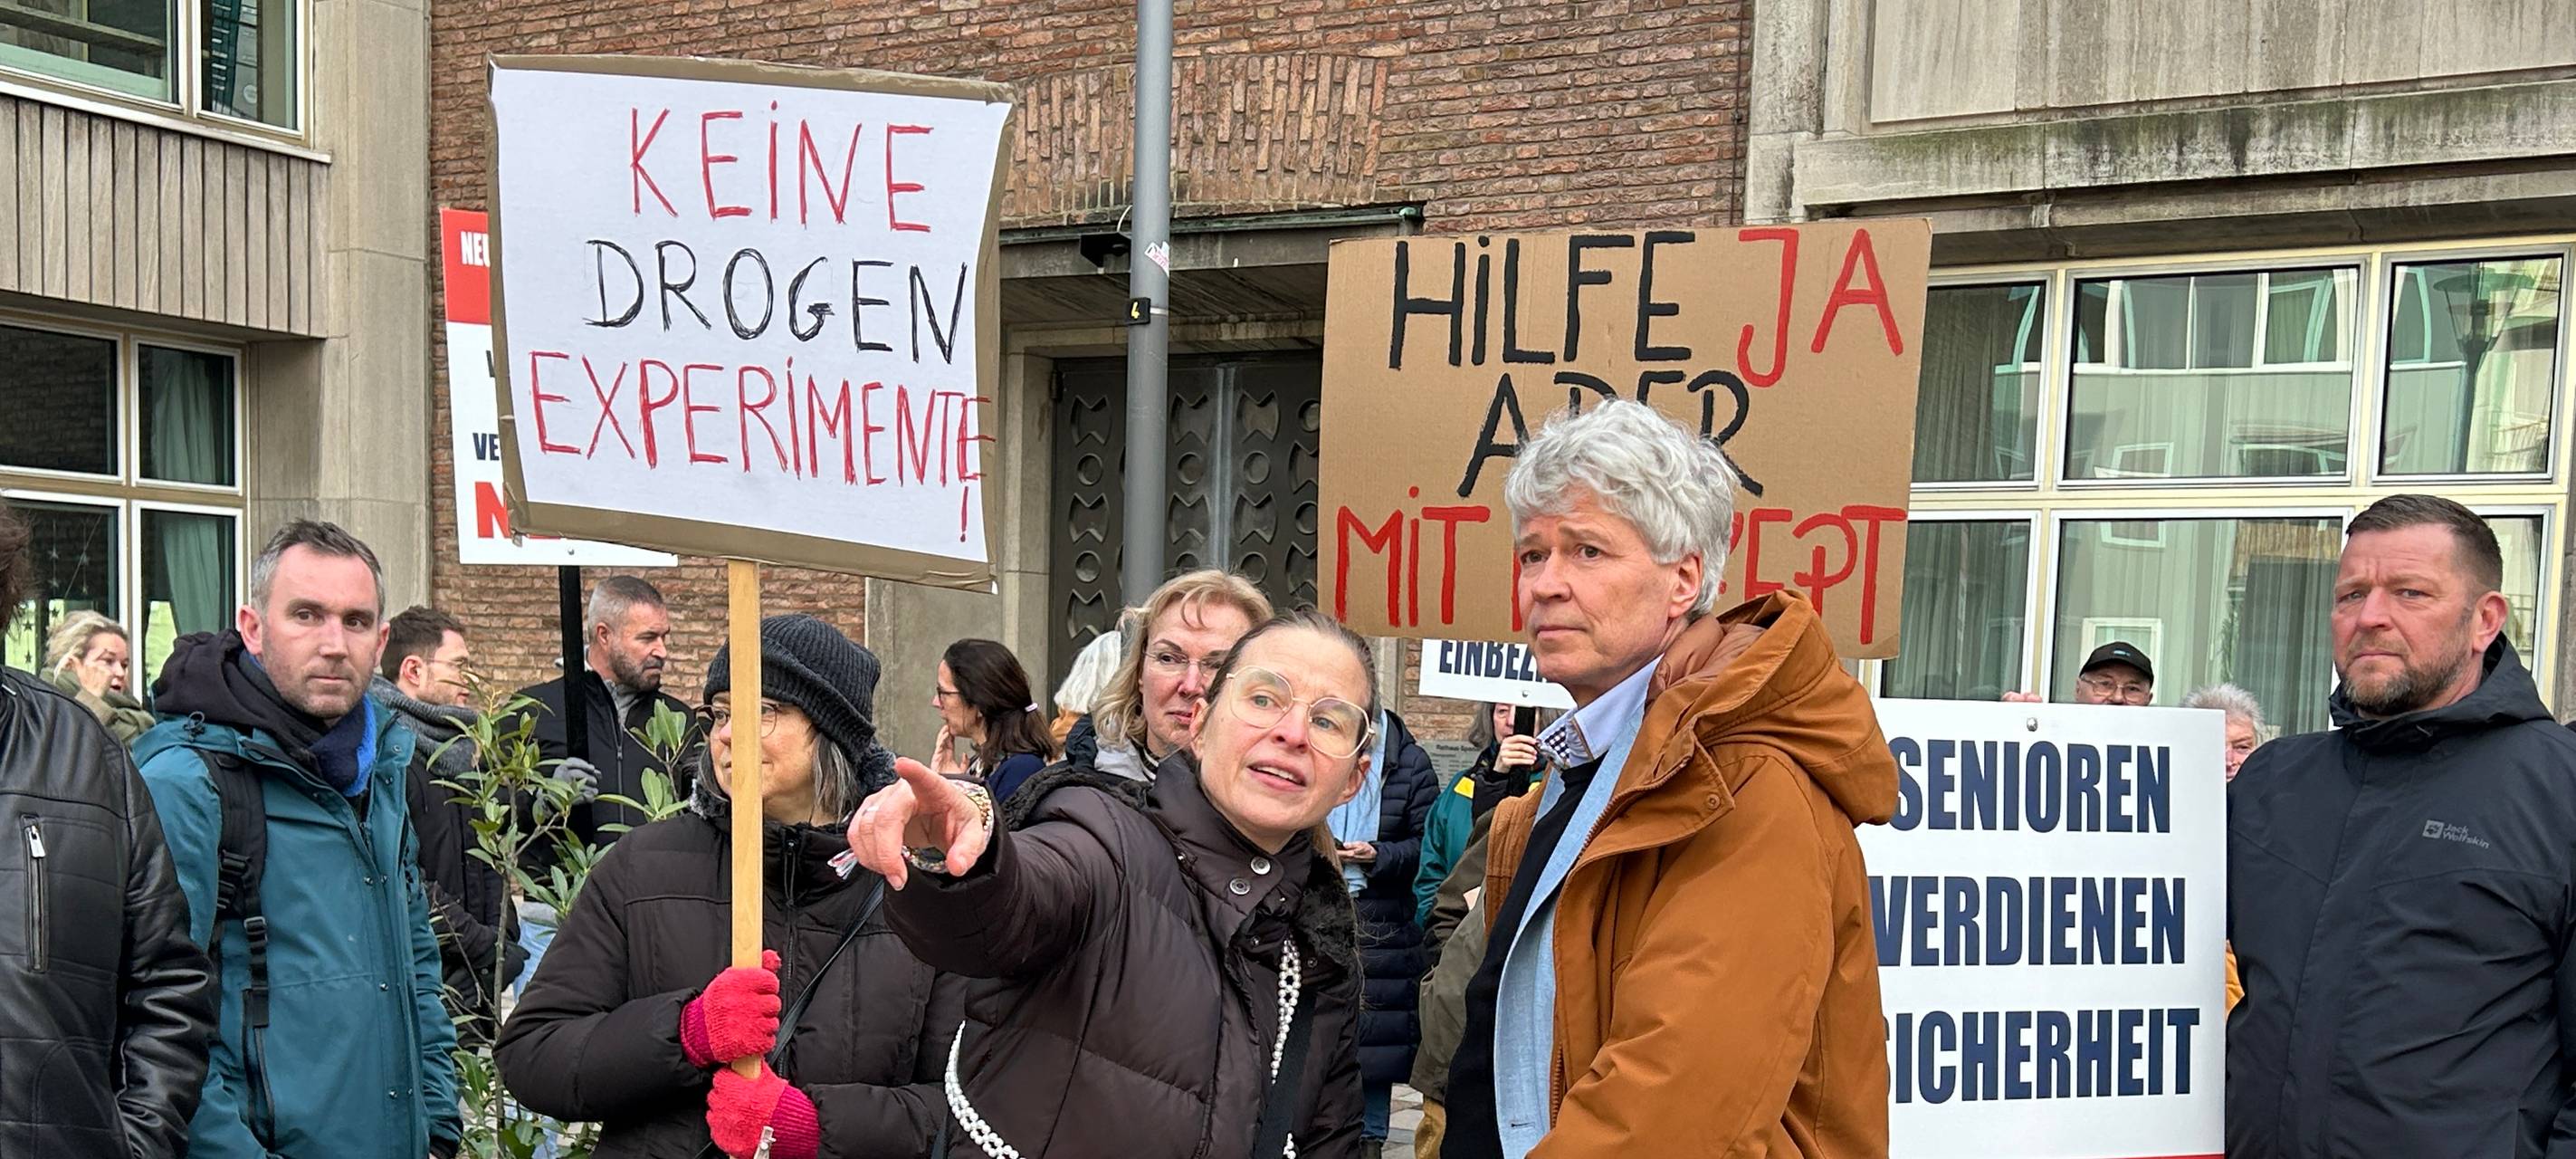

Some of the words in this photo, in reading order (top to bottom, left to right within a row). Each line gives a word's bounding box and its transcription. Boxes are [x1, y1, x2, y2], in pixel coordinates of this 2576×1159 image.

[583, 239, 968, 364] DROGEN
[1737, 228, 1903, 388] JA
[1889, 736, 2171, 834] SENIOREN
[2445, 823, 2468, 833] Jack
[2443, 831, 2490, 849] Wolfskin
[1867, 876, 2187, 967] VERDIENEN
[1883, 1007, 2200, 1105] ICHERHEIT
